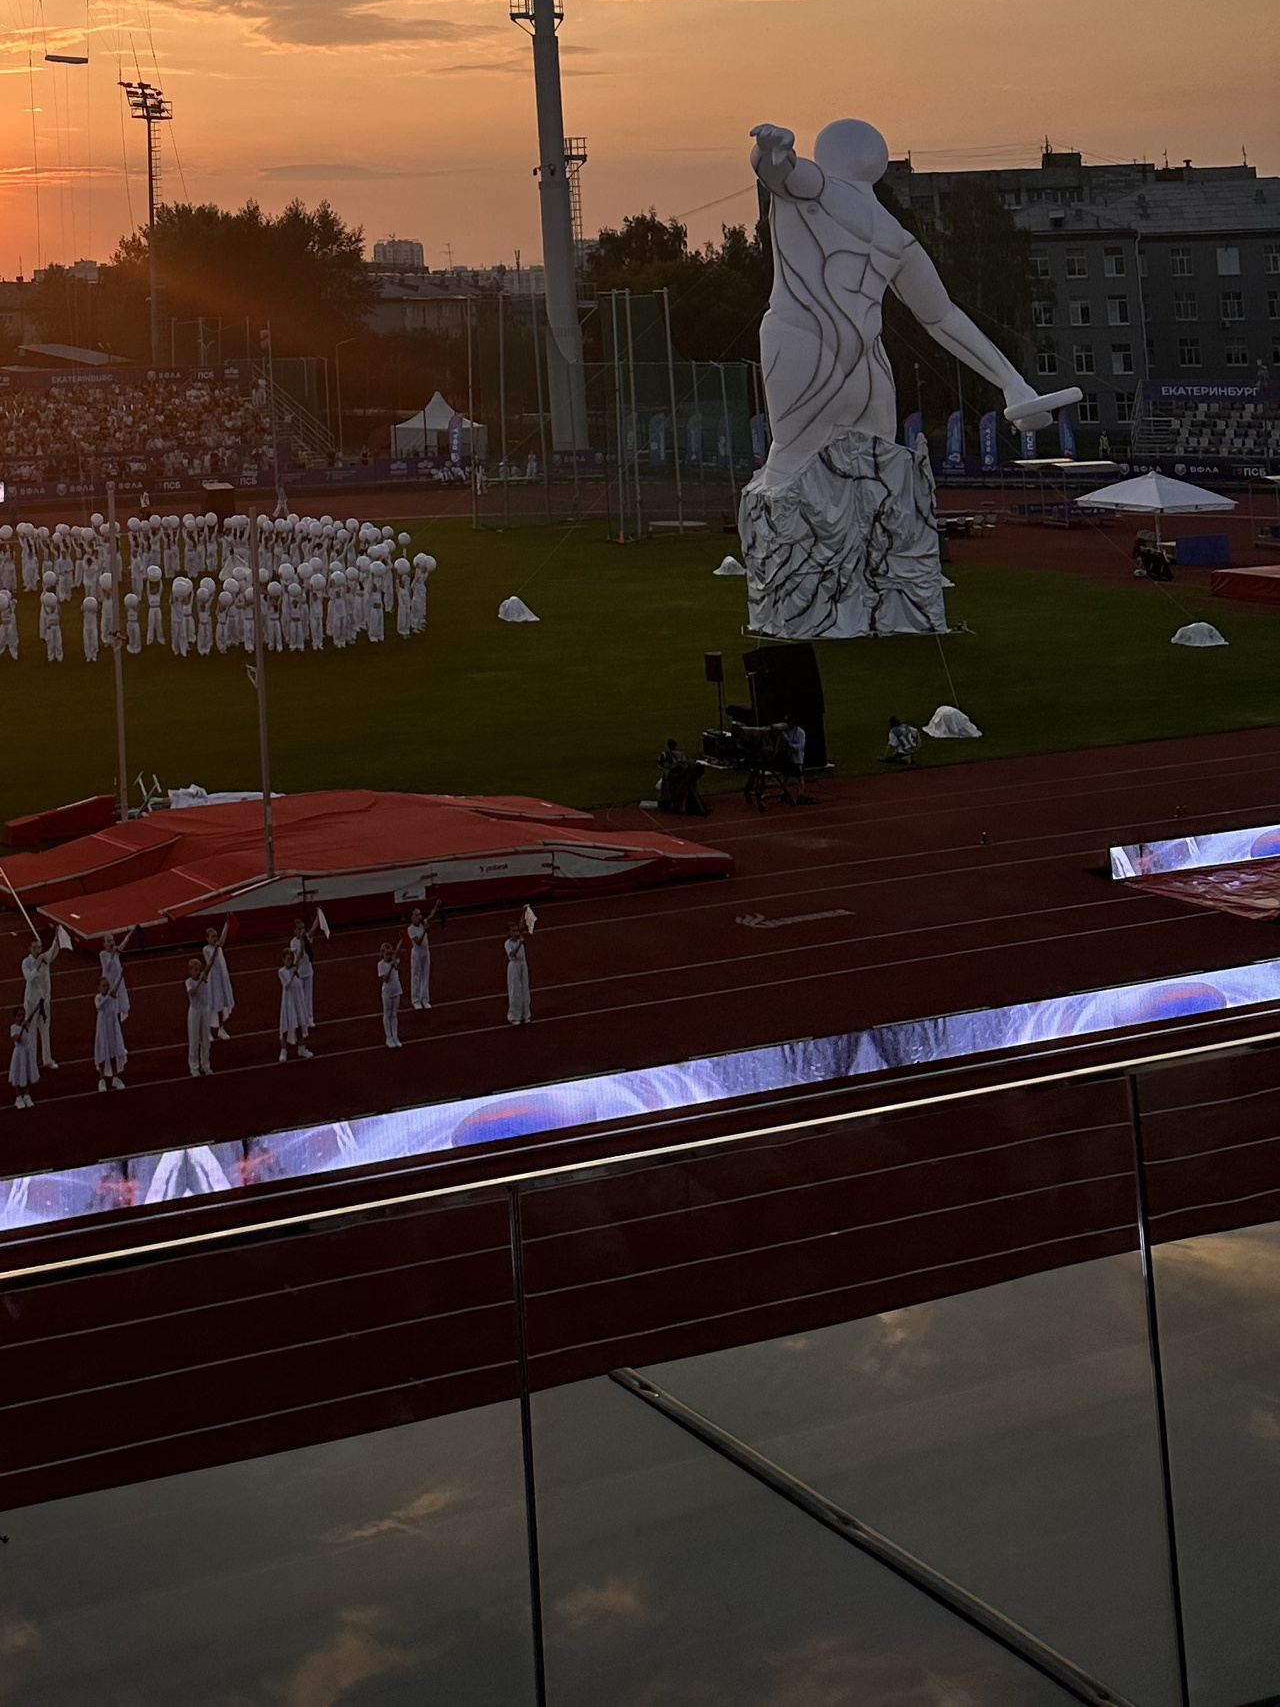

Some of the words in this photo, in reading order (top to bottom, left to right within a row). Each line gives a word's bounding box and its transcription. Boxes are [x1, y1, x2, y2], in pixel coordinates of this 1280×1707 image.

[1161, 386, 1258, 397] ЕКАТЕРИНБУРГ
[1190, 466, 1219, 474] ВФЛА
[1243, 467, 1266, 477] ПСБ
[163, 481, 181, 490] ПСБ
[239, 477, 257, 486] ПСБ
